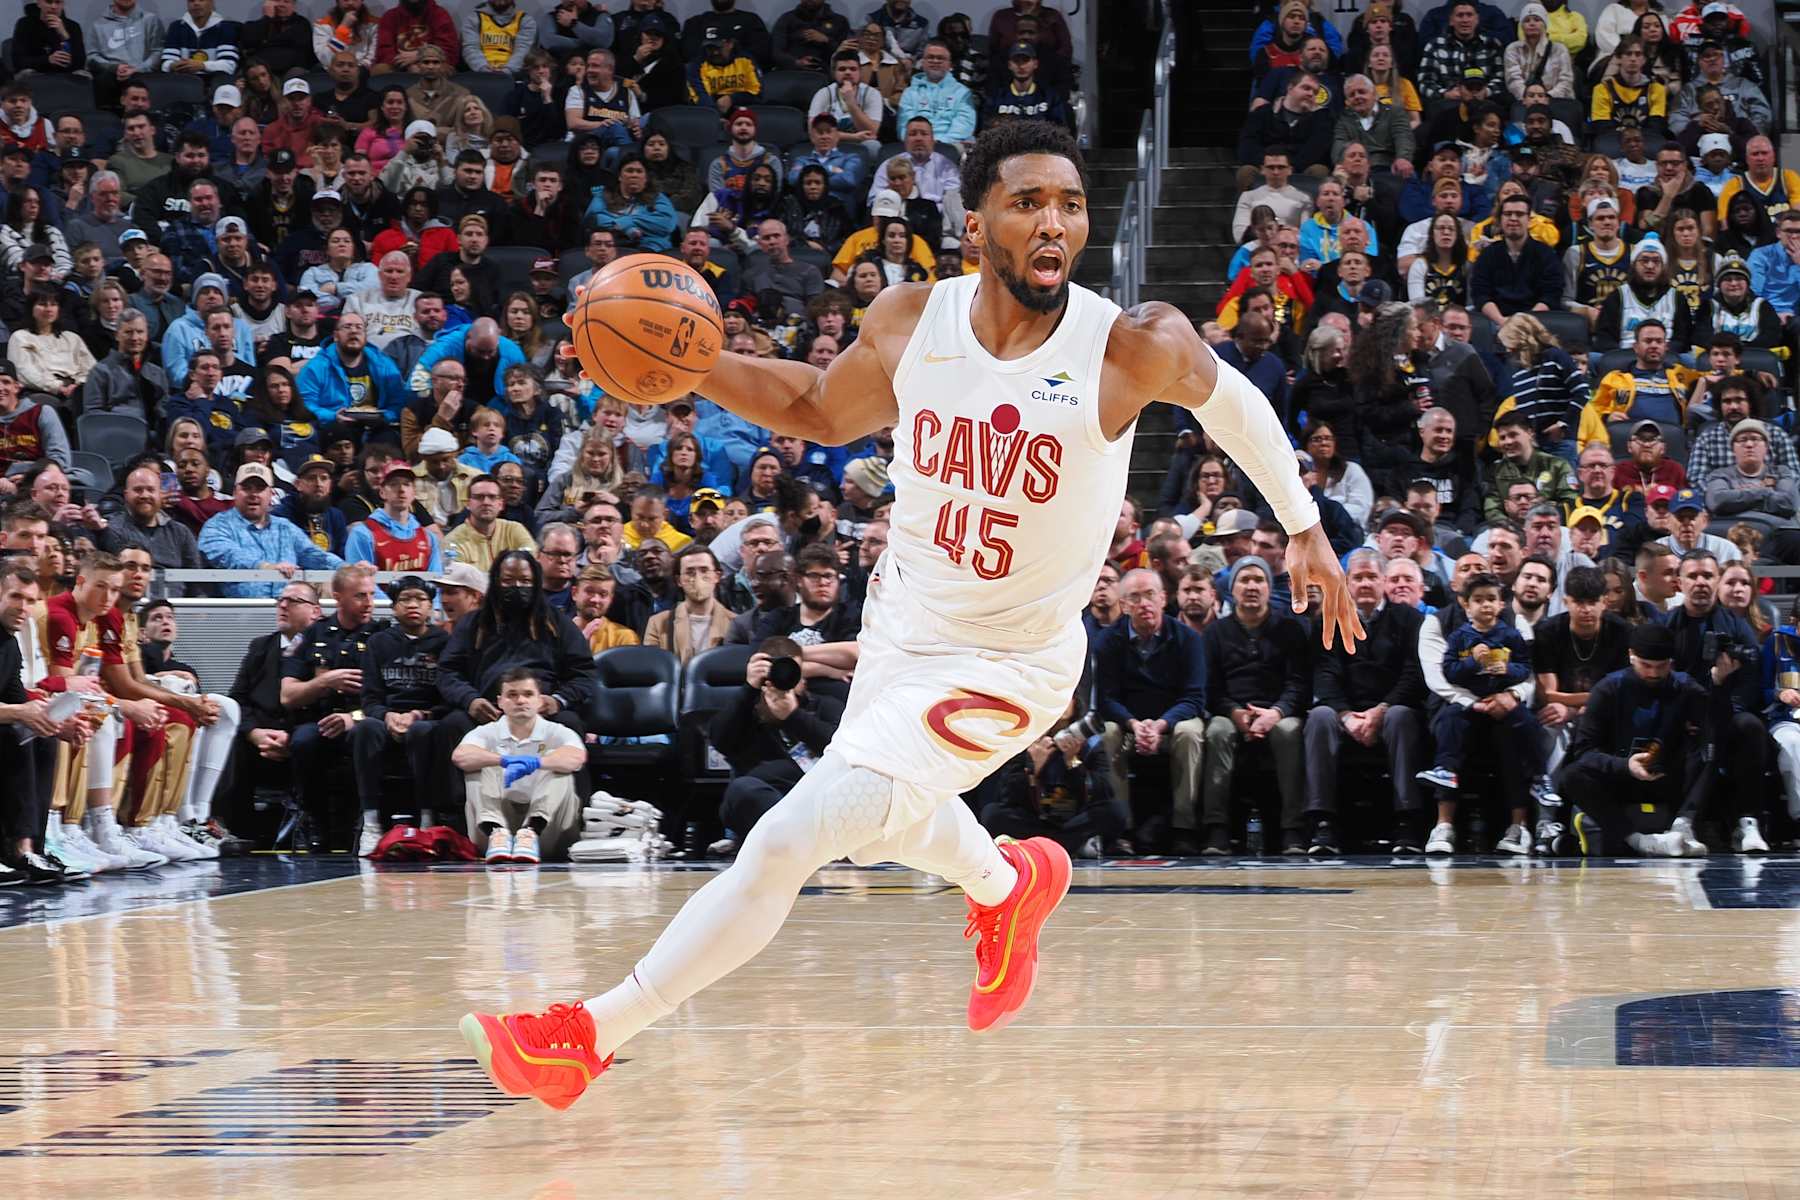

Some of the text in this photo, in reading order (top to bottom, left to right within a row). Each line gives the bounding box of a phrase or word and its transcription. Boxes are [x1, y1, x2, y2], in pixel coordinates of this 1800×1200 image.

[640, 269, 724, 320] Wilson
[1031, 390, 1079, 406] CLIFFS
[913, 408, 1063, 504] CAVS
[933, 499, 1019, 580] 45
